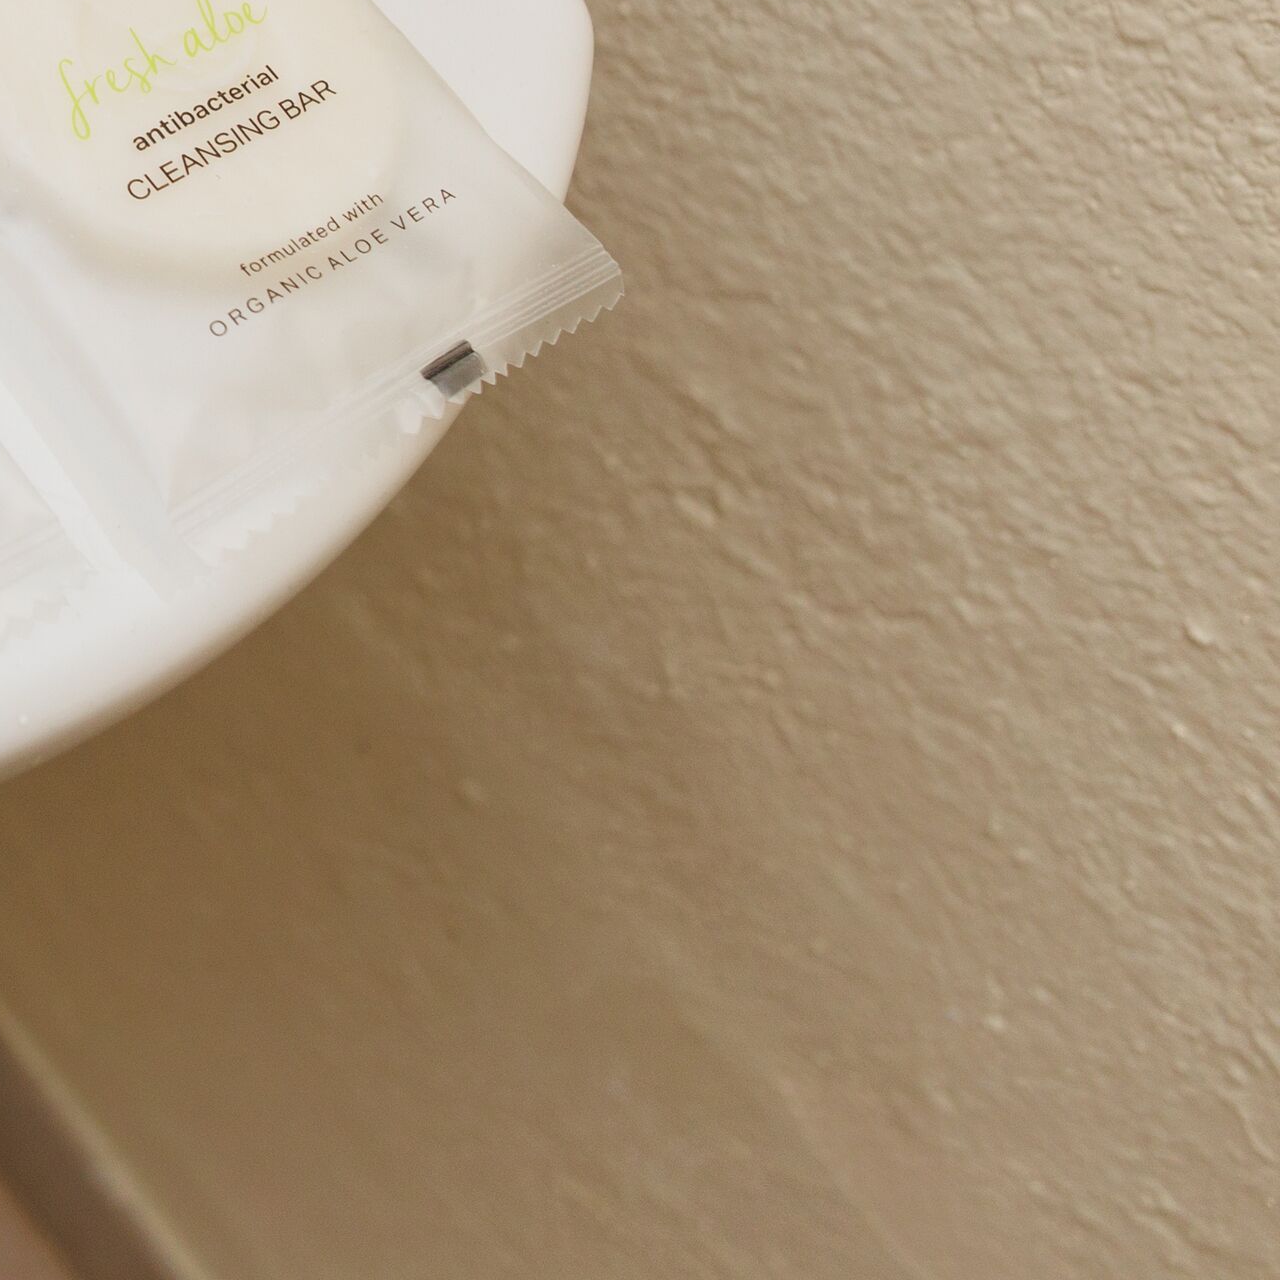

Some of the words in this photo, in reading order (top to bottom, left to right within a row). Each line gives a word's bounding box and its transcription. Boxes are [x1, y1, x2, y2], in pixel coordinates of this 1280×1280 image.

[58, 27, 176, 140] fresh
[132, 64, 279, 152] antibacterial
[126, 109, 280, 202] CLEANSING
[279, 79, 337, 120] BAR
[209, 265, 323, 337] ORGANIC
[327, 229, 388, 271] ALOE
[391, 187, 456, 232] VERA
[240, 216, 341, 278] formulated
[342, 191, 384, 222] with
